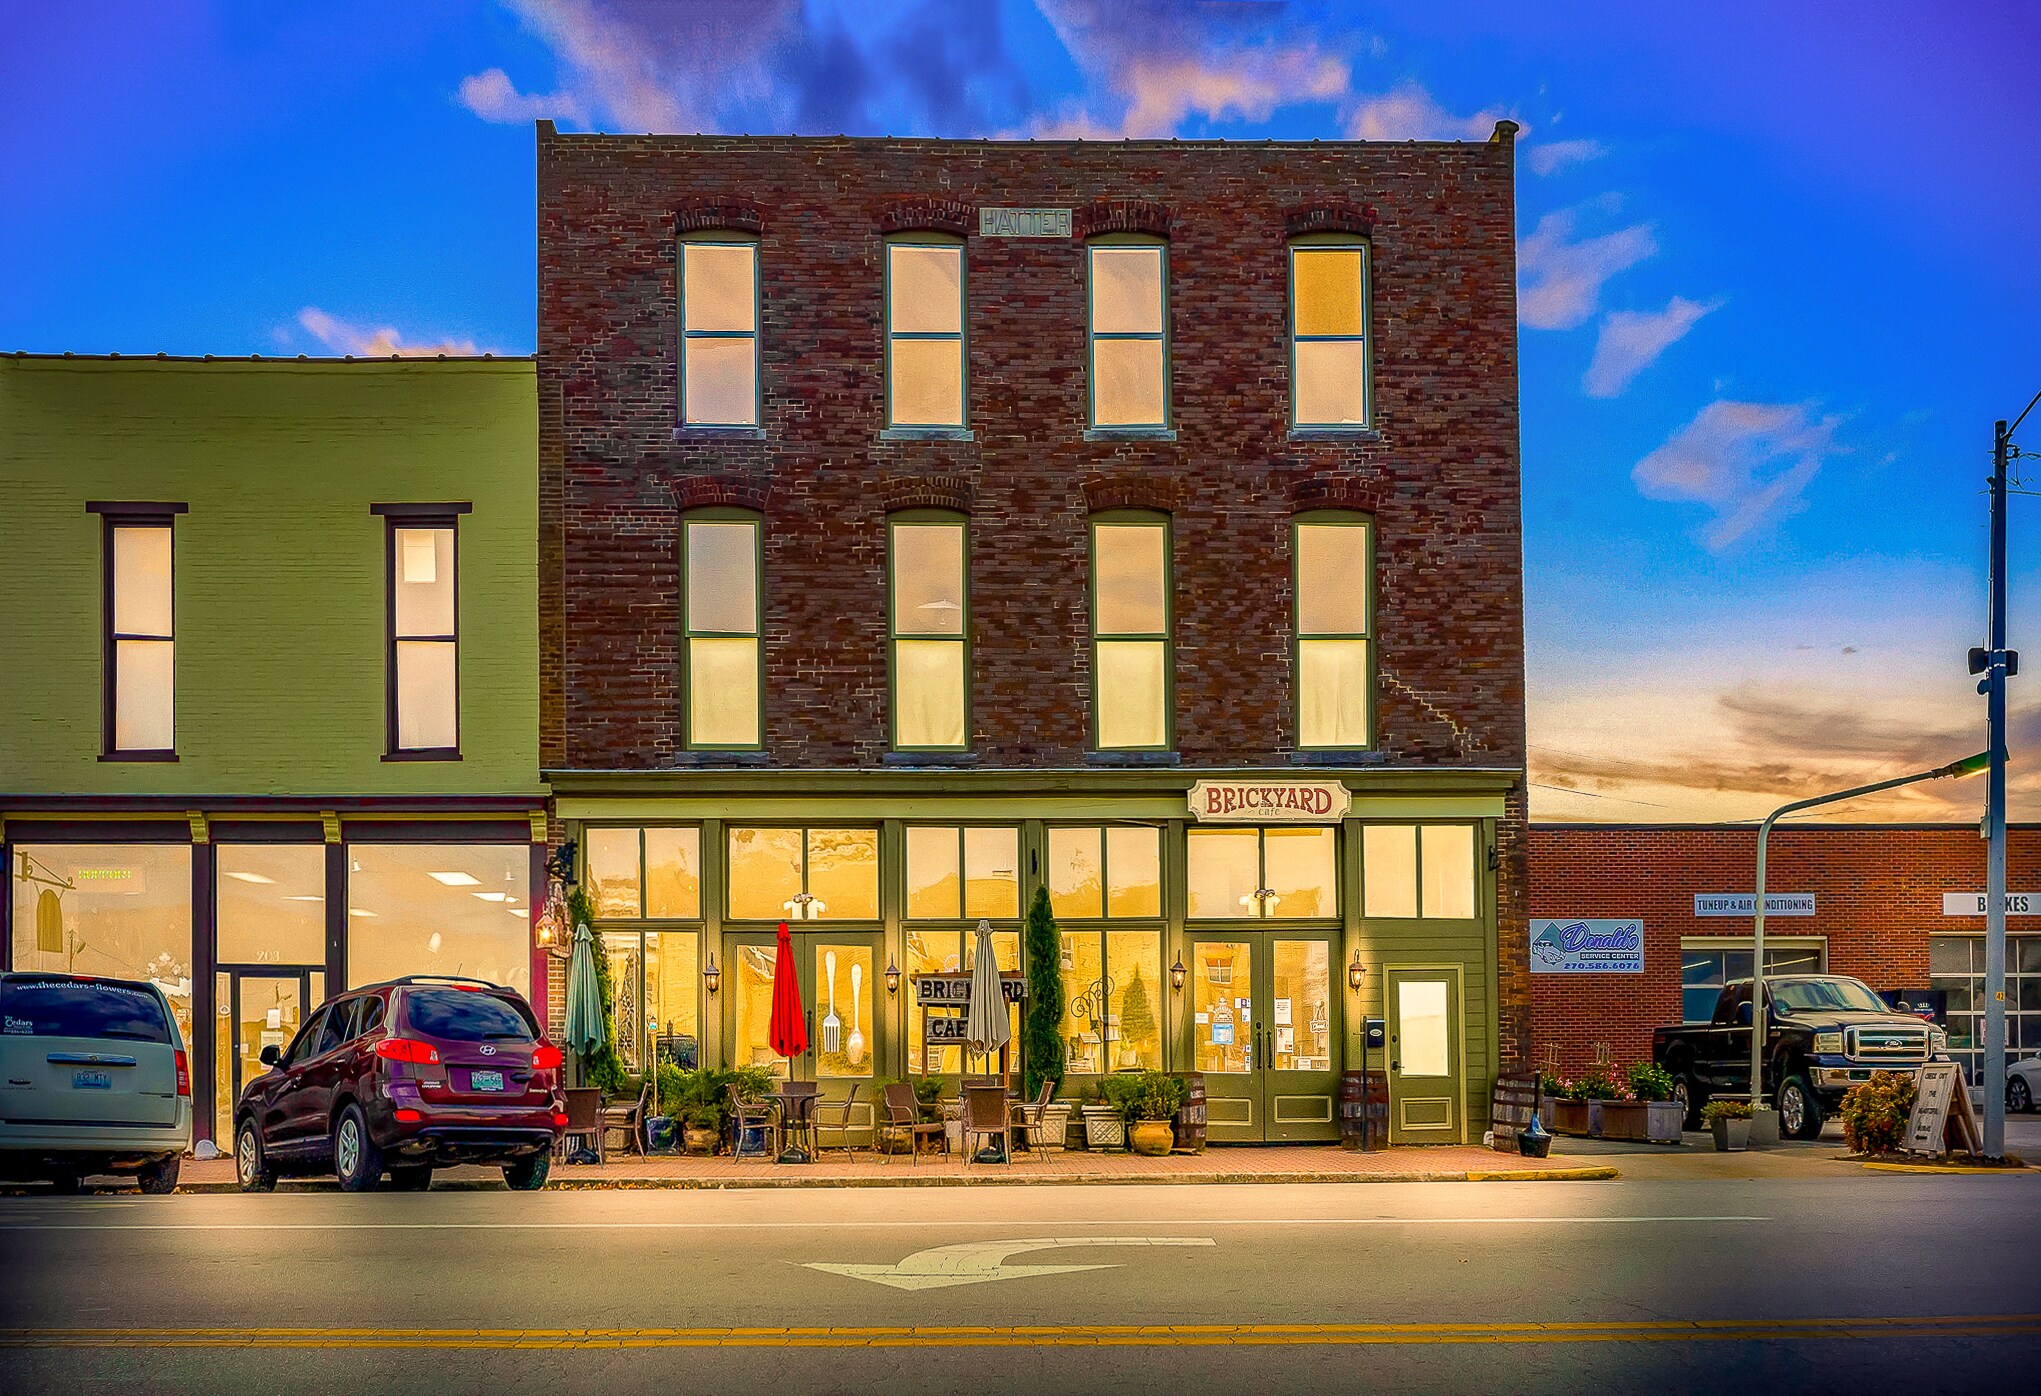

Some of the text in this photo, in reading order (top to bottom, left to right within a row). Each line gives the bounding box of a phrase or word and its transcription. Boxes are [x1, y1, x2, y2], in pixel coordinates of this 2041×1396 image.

[981, 209, 1071, 236] HATTER
[1206, 788, 1332, 814] BRICKYARD
[1258, 807, 1280, 816] cafe
[1697, 899, 1813, 911] TUNEUP & AIR NDITIONING
[1977, 896, 2029, 912] BKES
[1560, 922, 1639, 952] Donald's
[1564, 962, 1640, 970] 270.586.6076
[921, 980, 1024, 998] BRICRD
[932, 1019, 968, 1037] CAF
